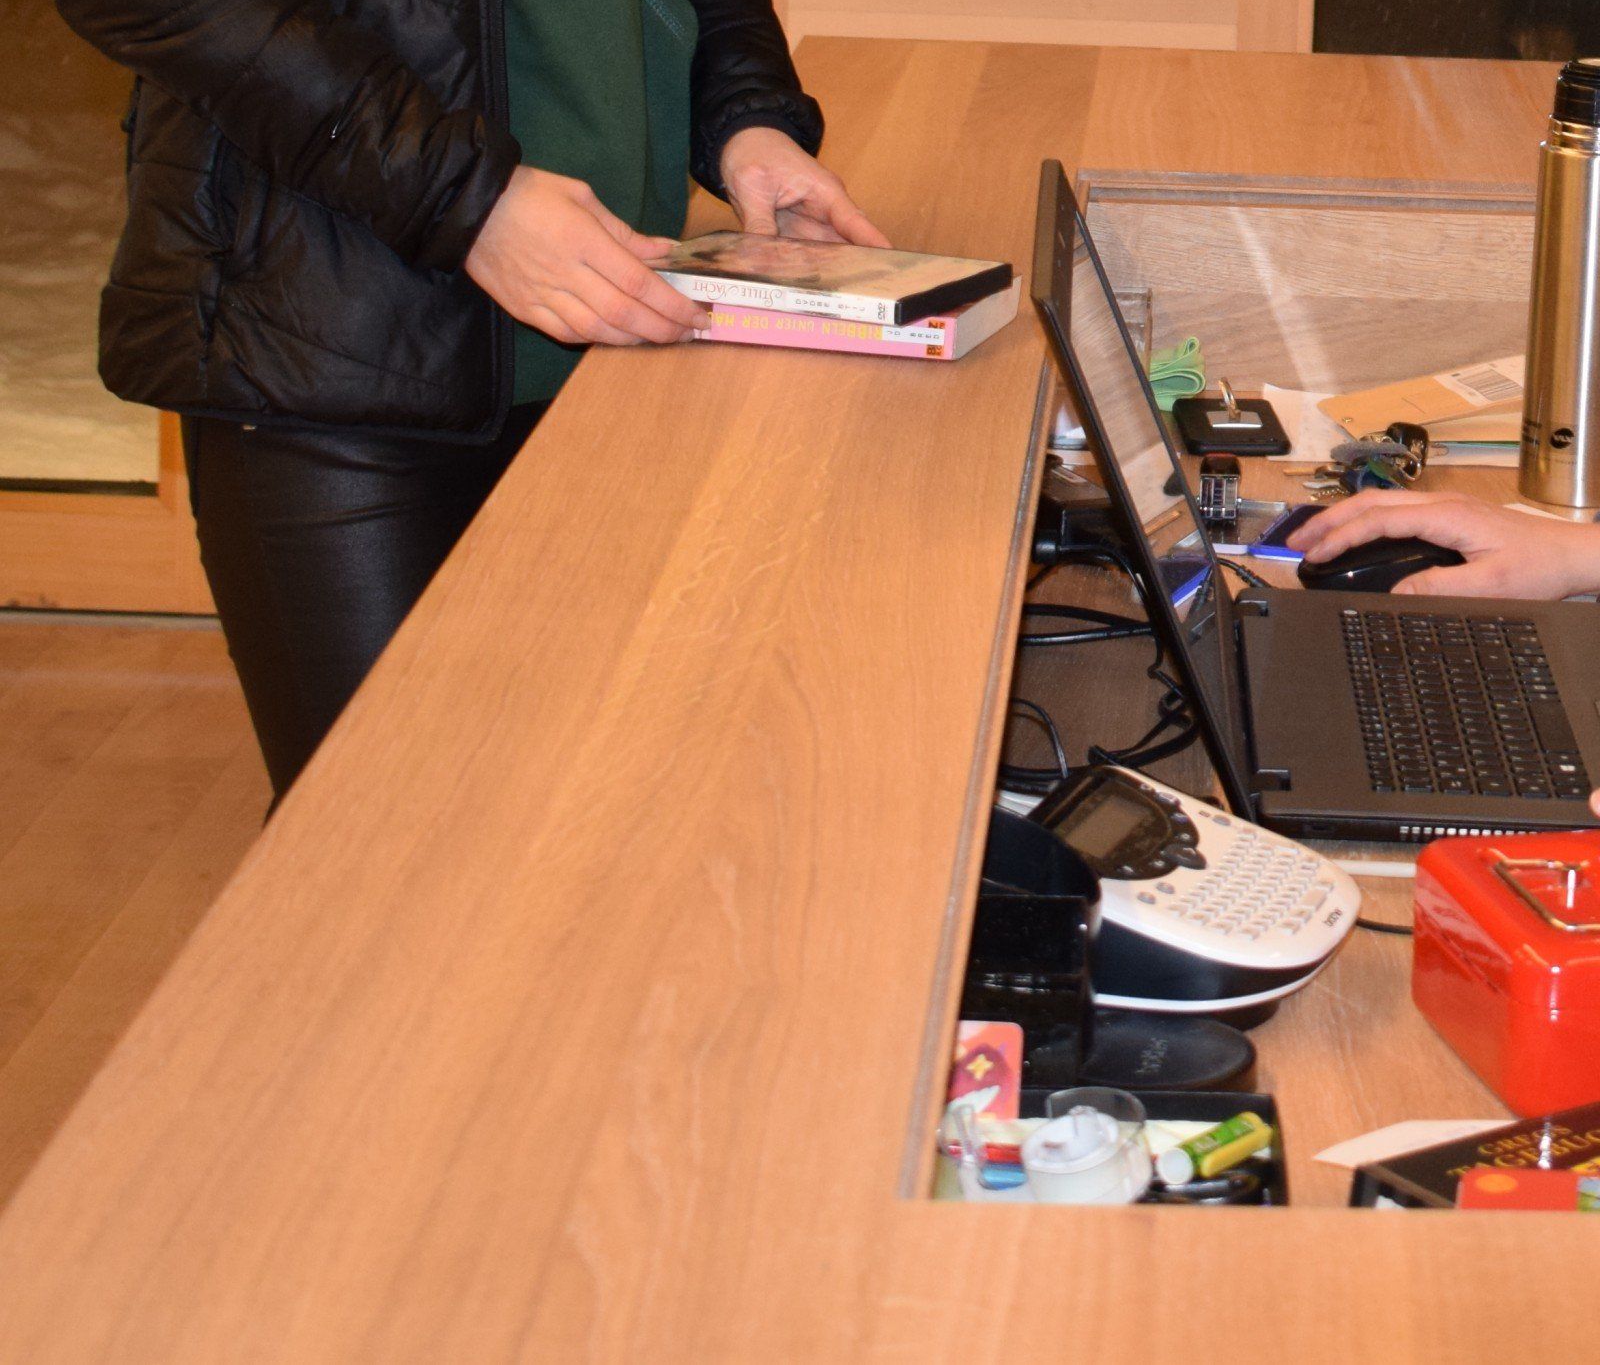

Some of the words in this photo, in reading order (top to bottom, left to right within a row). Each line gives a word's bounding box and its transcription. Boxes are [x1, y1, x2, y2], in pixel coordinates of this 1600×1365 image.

[692, 279, 738, 300] NACHT
[741, 287, 783, 307] STILLE
[742, 314, 769, 330] DER
[776, 316, 815, 332] UNTER
[822, 321, 883, 341] RIBBELN
